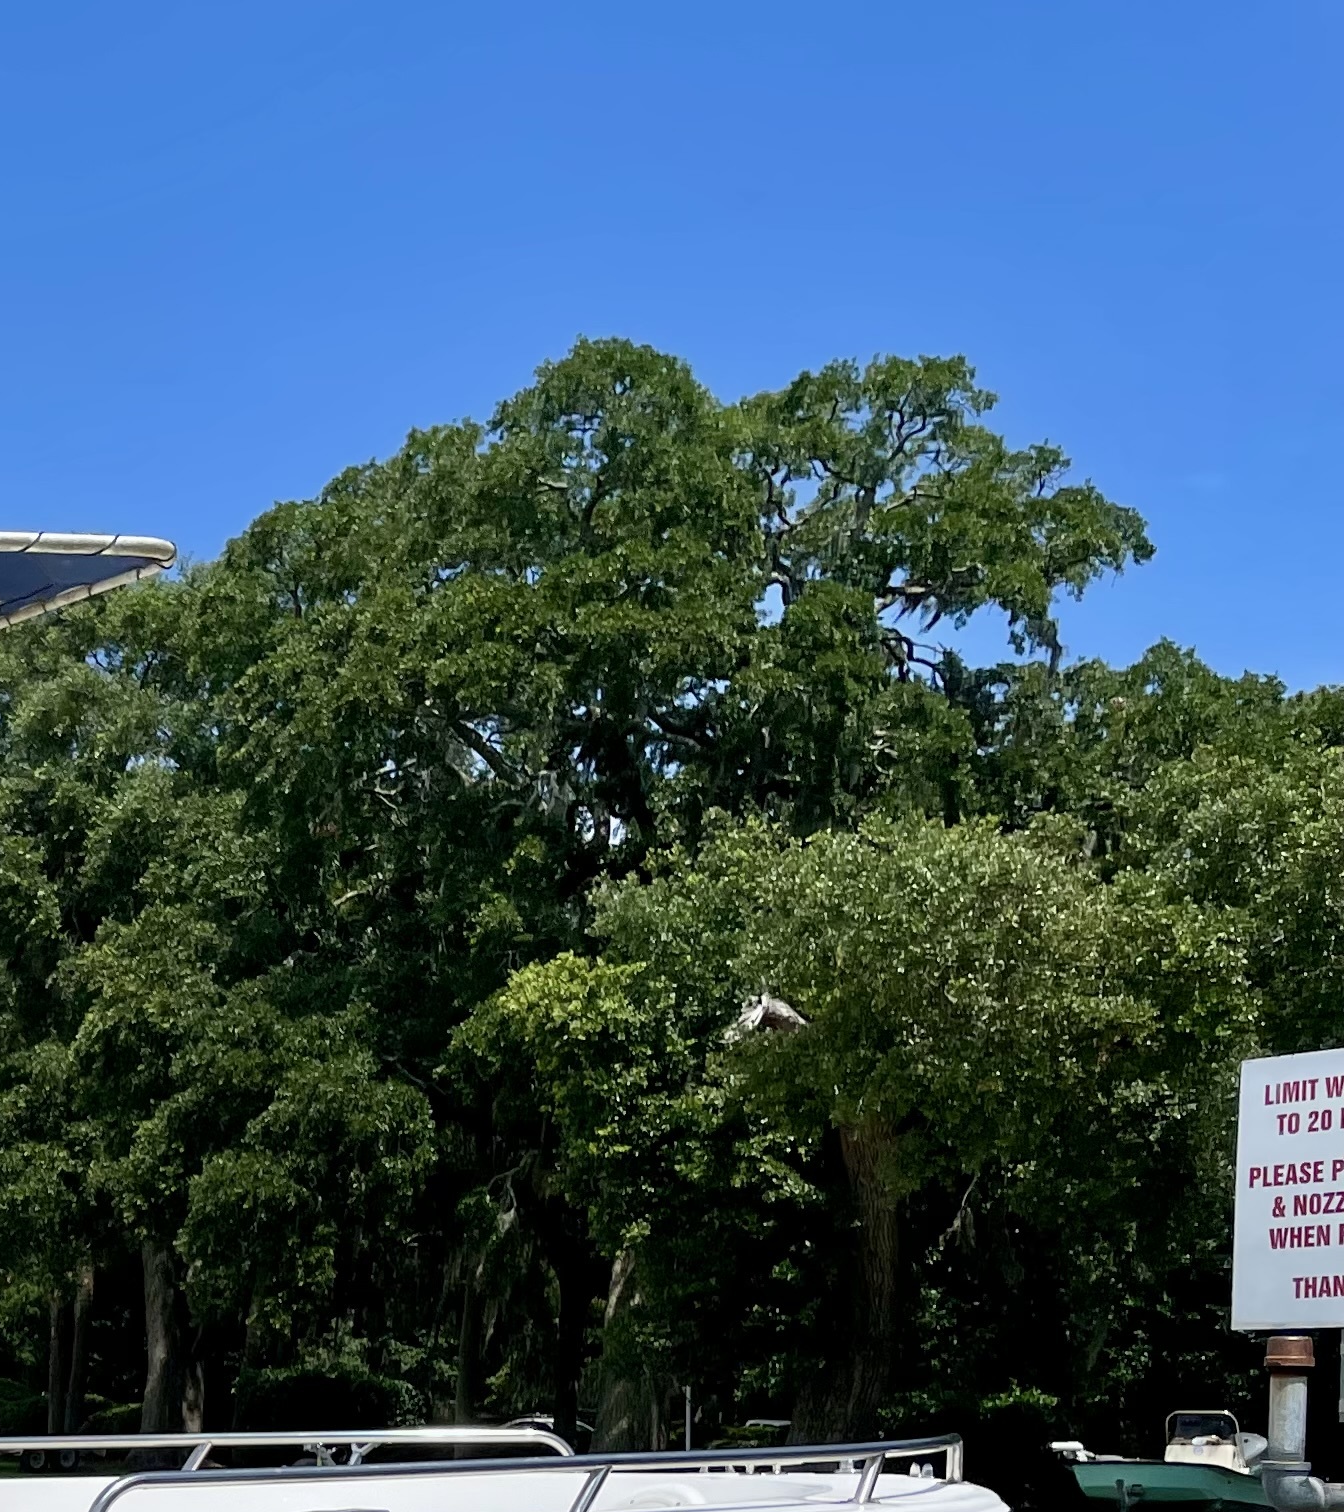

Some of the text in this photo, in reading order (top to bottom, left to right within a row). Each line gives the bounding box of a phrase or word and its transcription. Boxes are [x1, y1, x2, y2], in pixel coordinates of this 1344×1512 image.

[1265, 1078, 1319, 1106] LIMIT
[1276, 1113, 1300, 1135] TO
[1308, 1109, 1332, 1132] 20
[1249, 1160, 1324, 1188] PLEASE
[1272, 1195, 1286, 1218] &
[1269, 1224, 1330, 1249] WHEN
